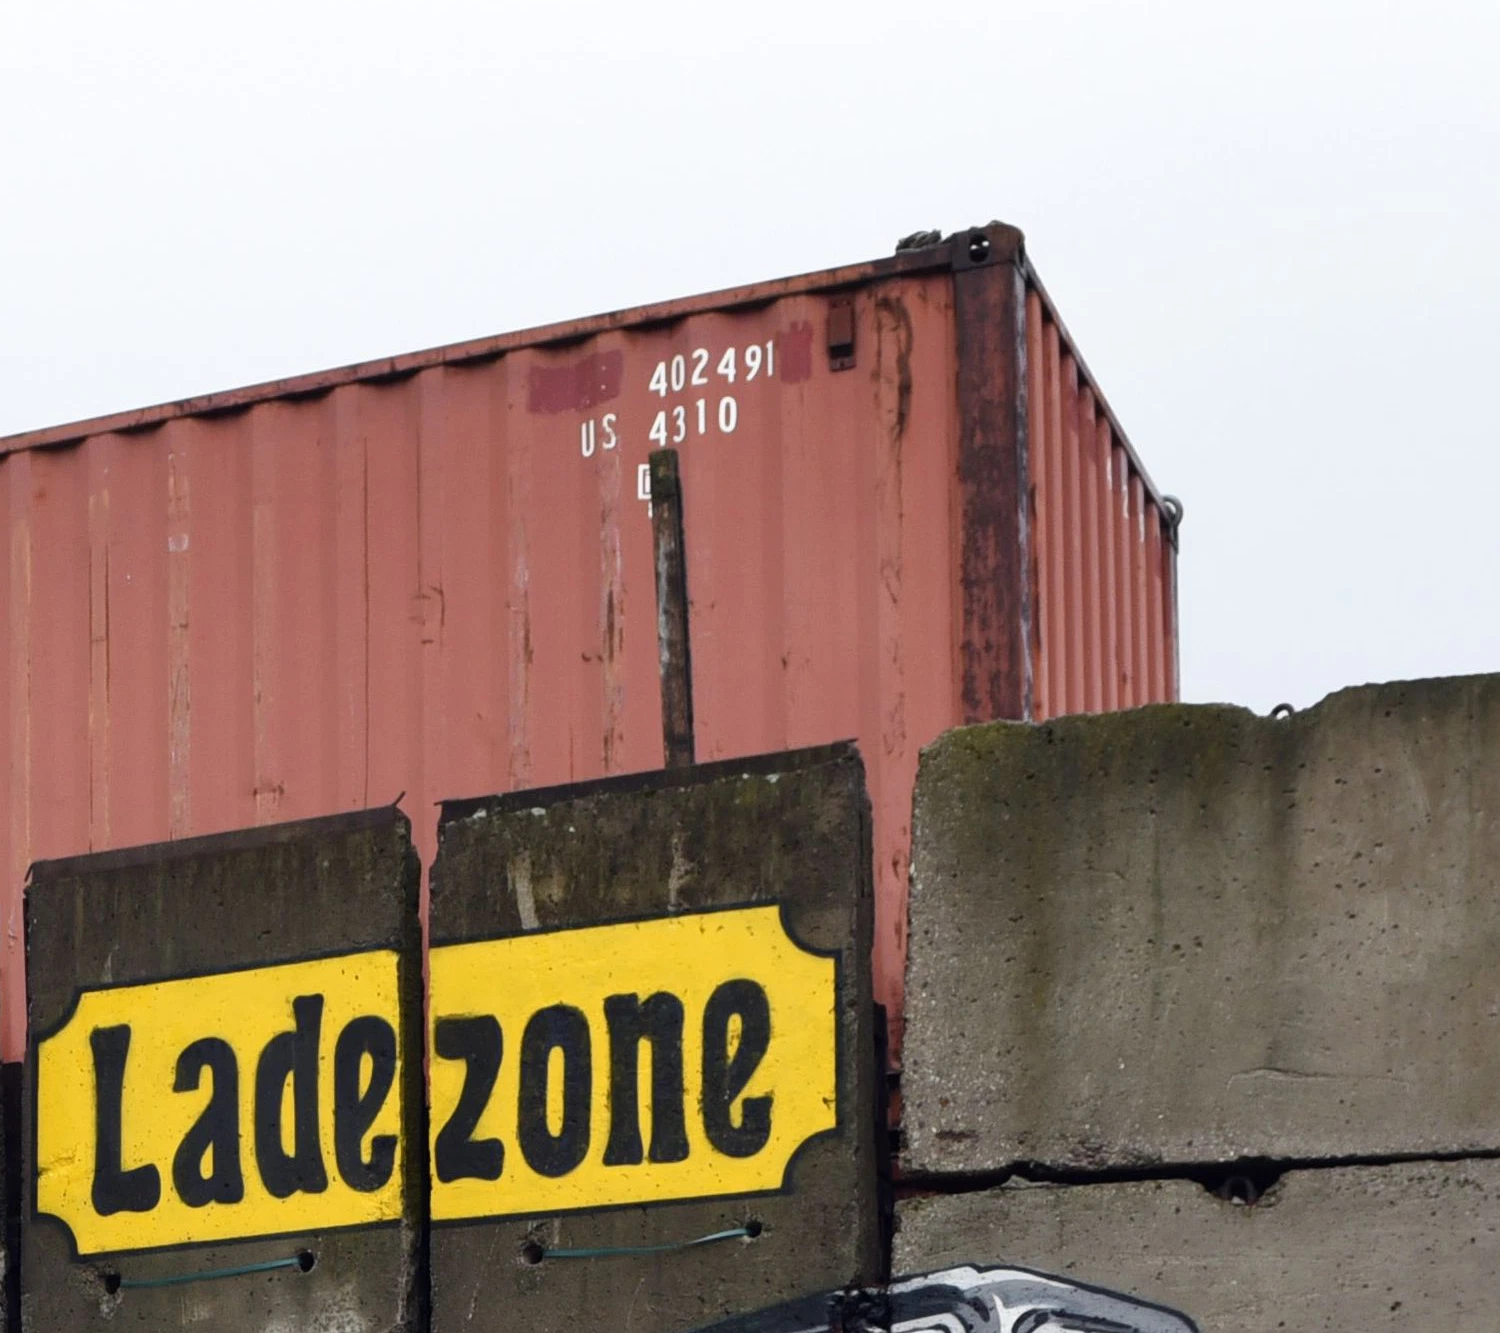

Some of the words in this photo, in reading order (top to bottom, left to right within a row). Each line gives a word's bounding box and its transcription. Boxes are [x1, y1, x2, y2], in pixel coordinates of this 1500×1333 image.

[648, 339, 774, 397] 402491
[581, 413, 616, 457] US
[648, 396, 738, 446] 4310
